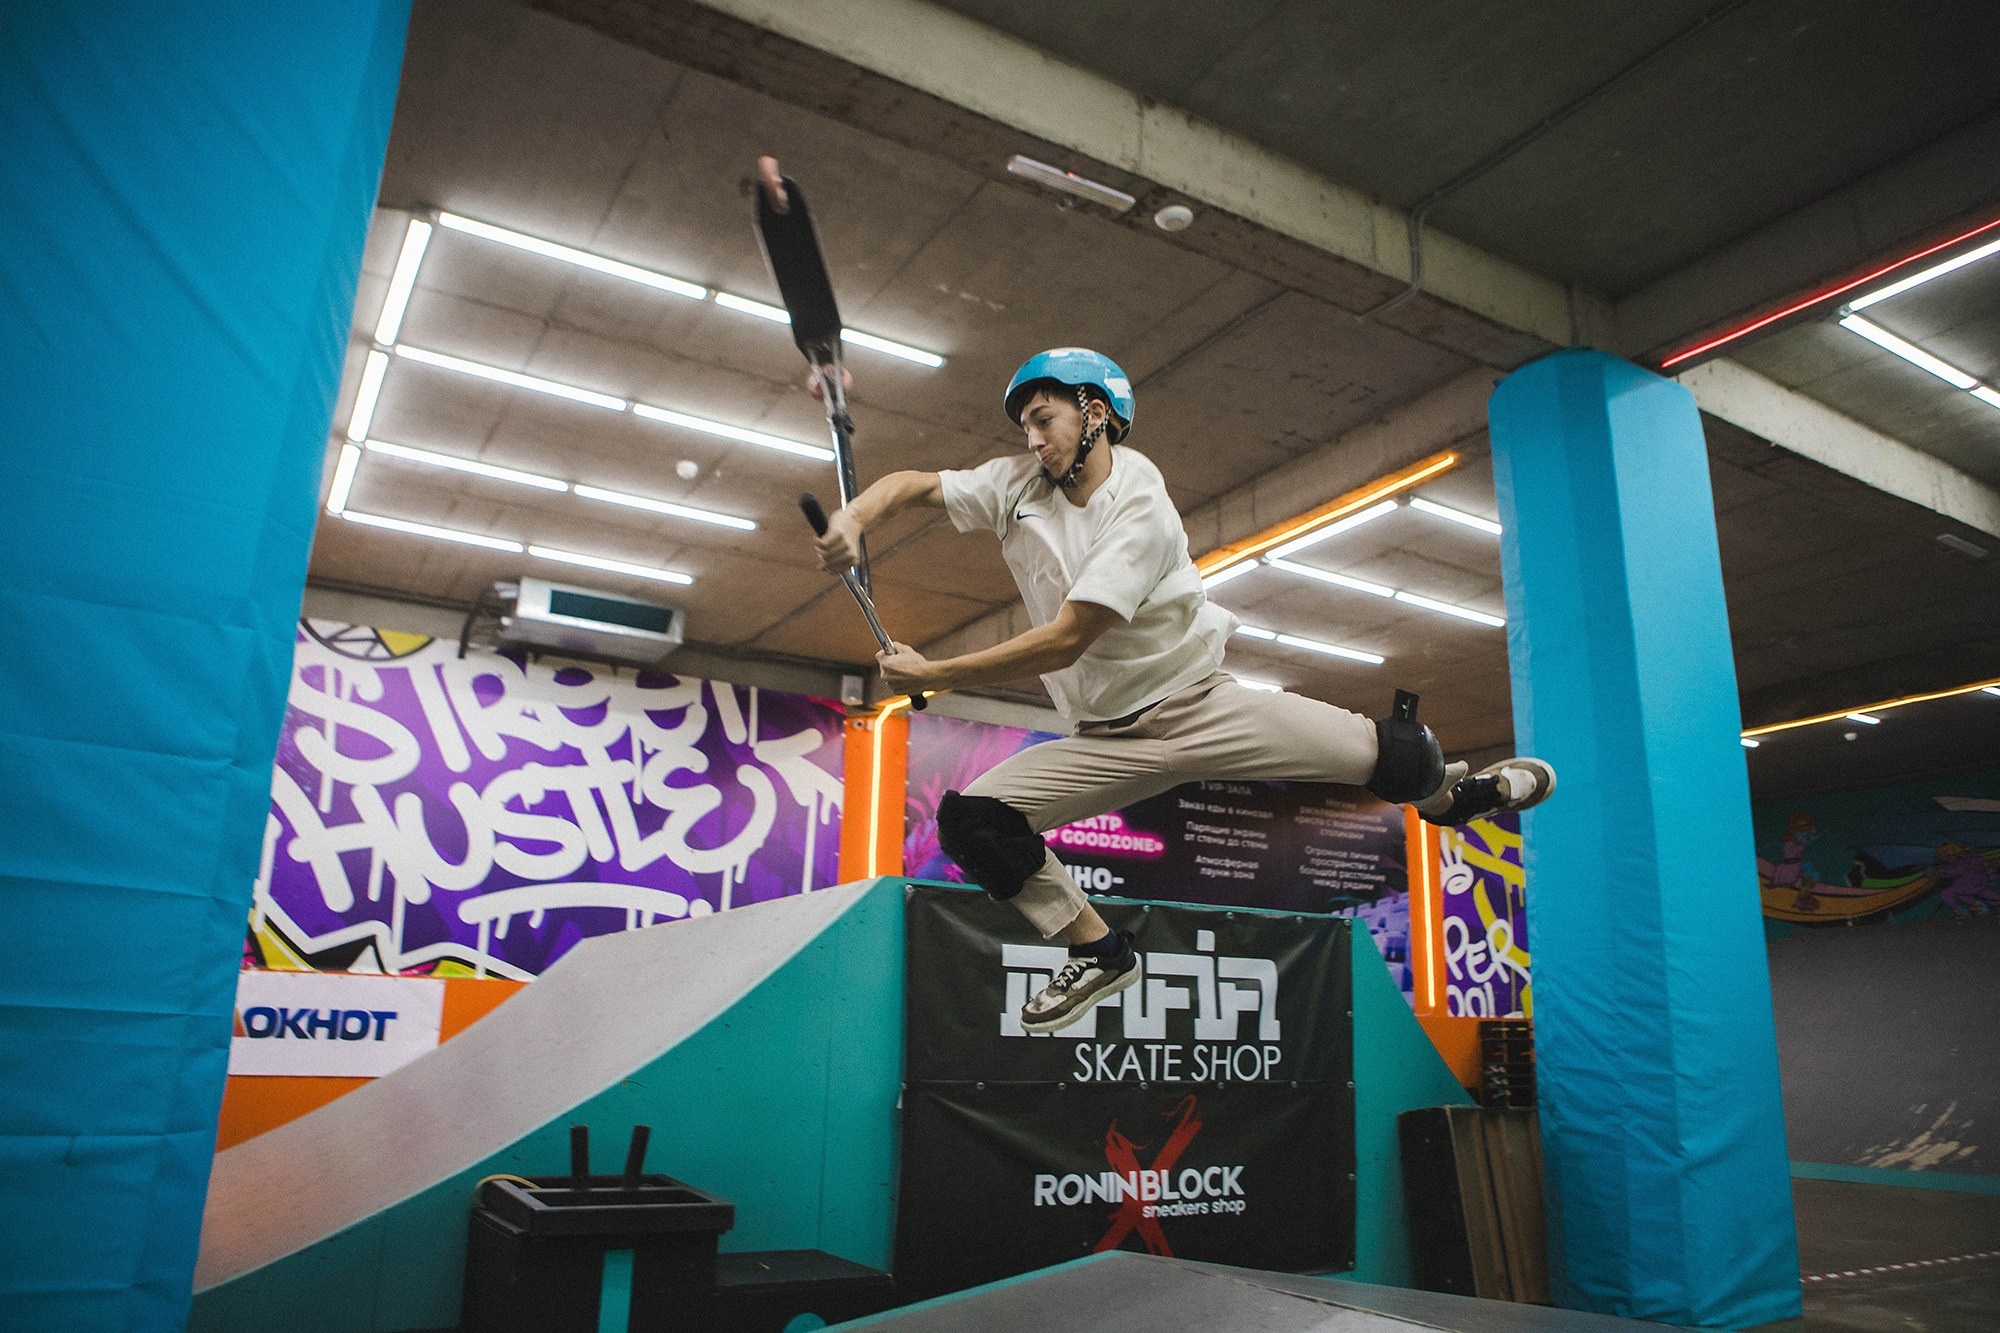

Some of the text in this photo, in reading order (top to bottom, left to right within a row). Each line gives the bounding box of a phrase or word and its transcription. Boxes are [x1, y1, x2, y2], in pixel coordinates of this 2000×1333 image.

[288, 645, 748, 785] STREET
[1179, 798, 1205, 812] Заказ
[276, 745, 778, 912] HUSTLE
[1232, 828, 1266, 840] экраны
[1183, 833, 1268, 850] от стены до стены
[1305, 845, 1379, 862] Огромное личное
[1195, 855, 1259, 870] Атмосферная
[1313, 879, 1341, 890] между
[1073, 1043, 1281, 1082] SKATE SHOP
[1034, 1165, 1246, 1207] RONINBLOCK
[1142, 1199, 1246, 1218] sneakers shop
